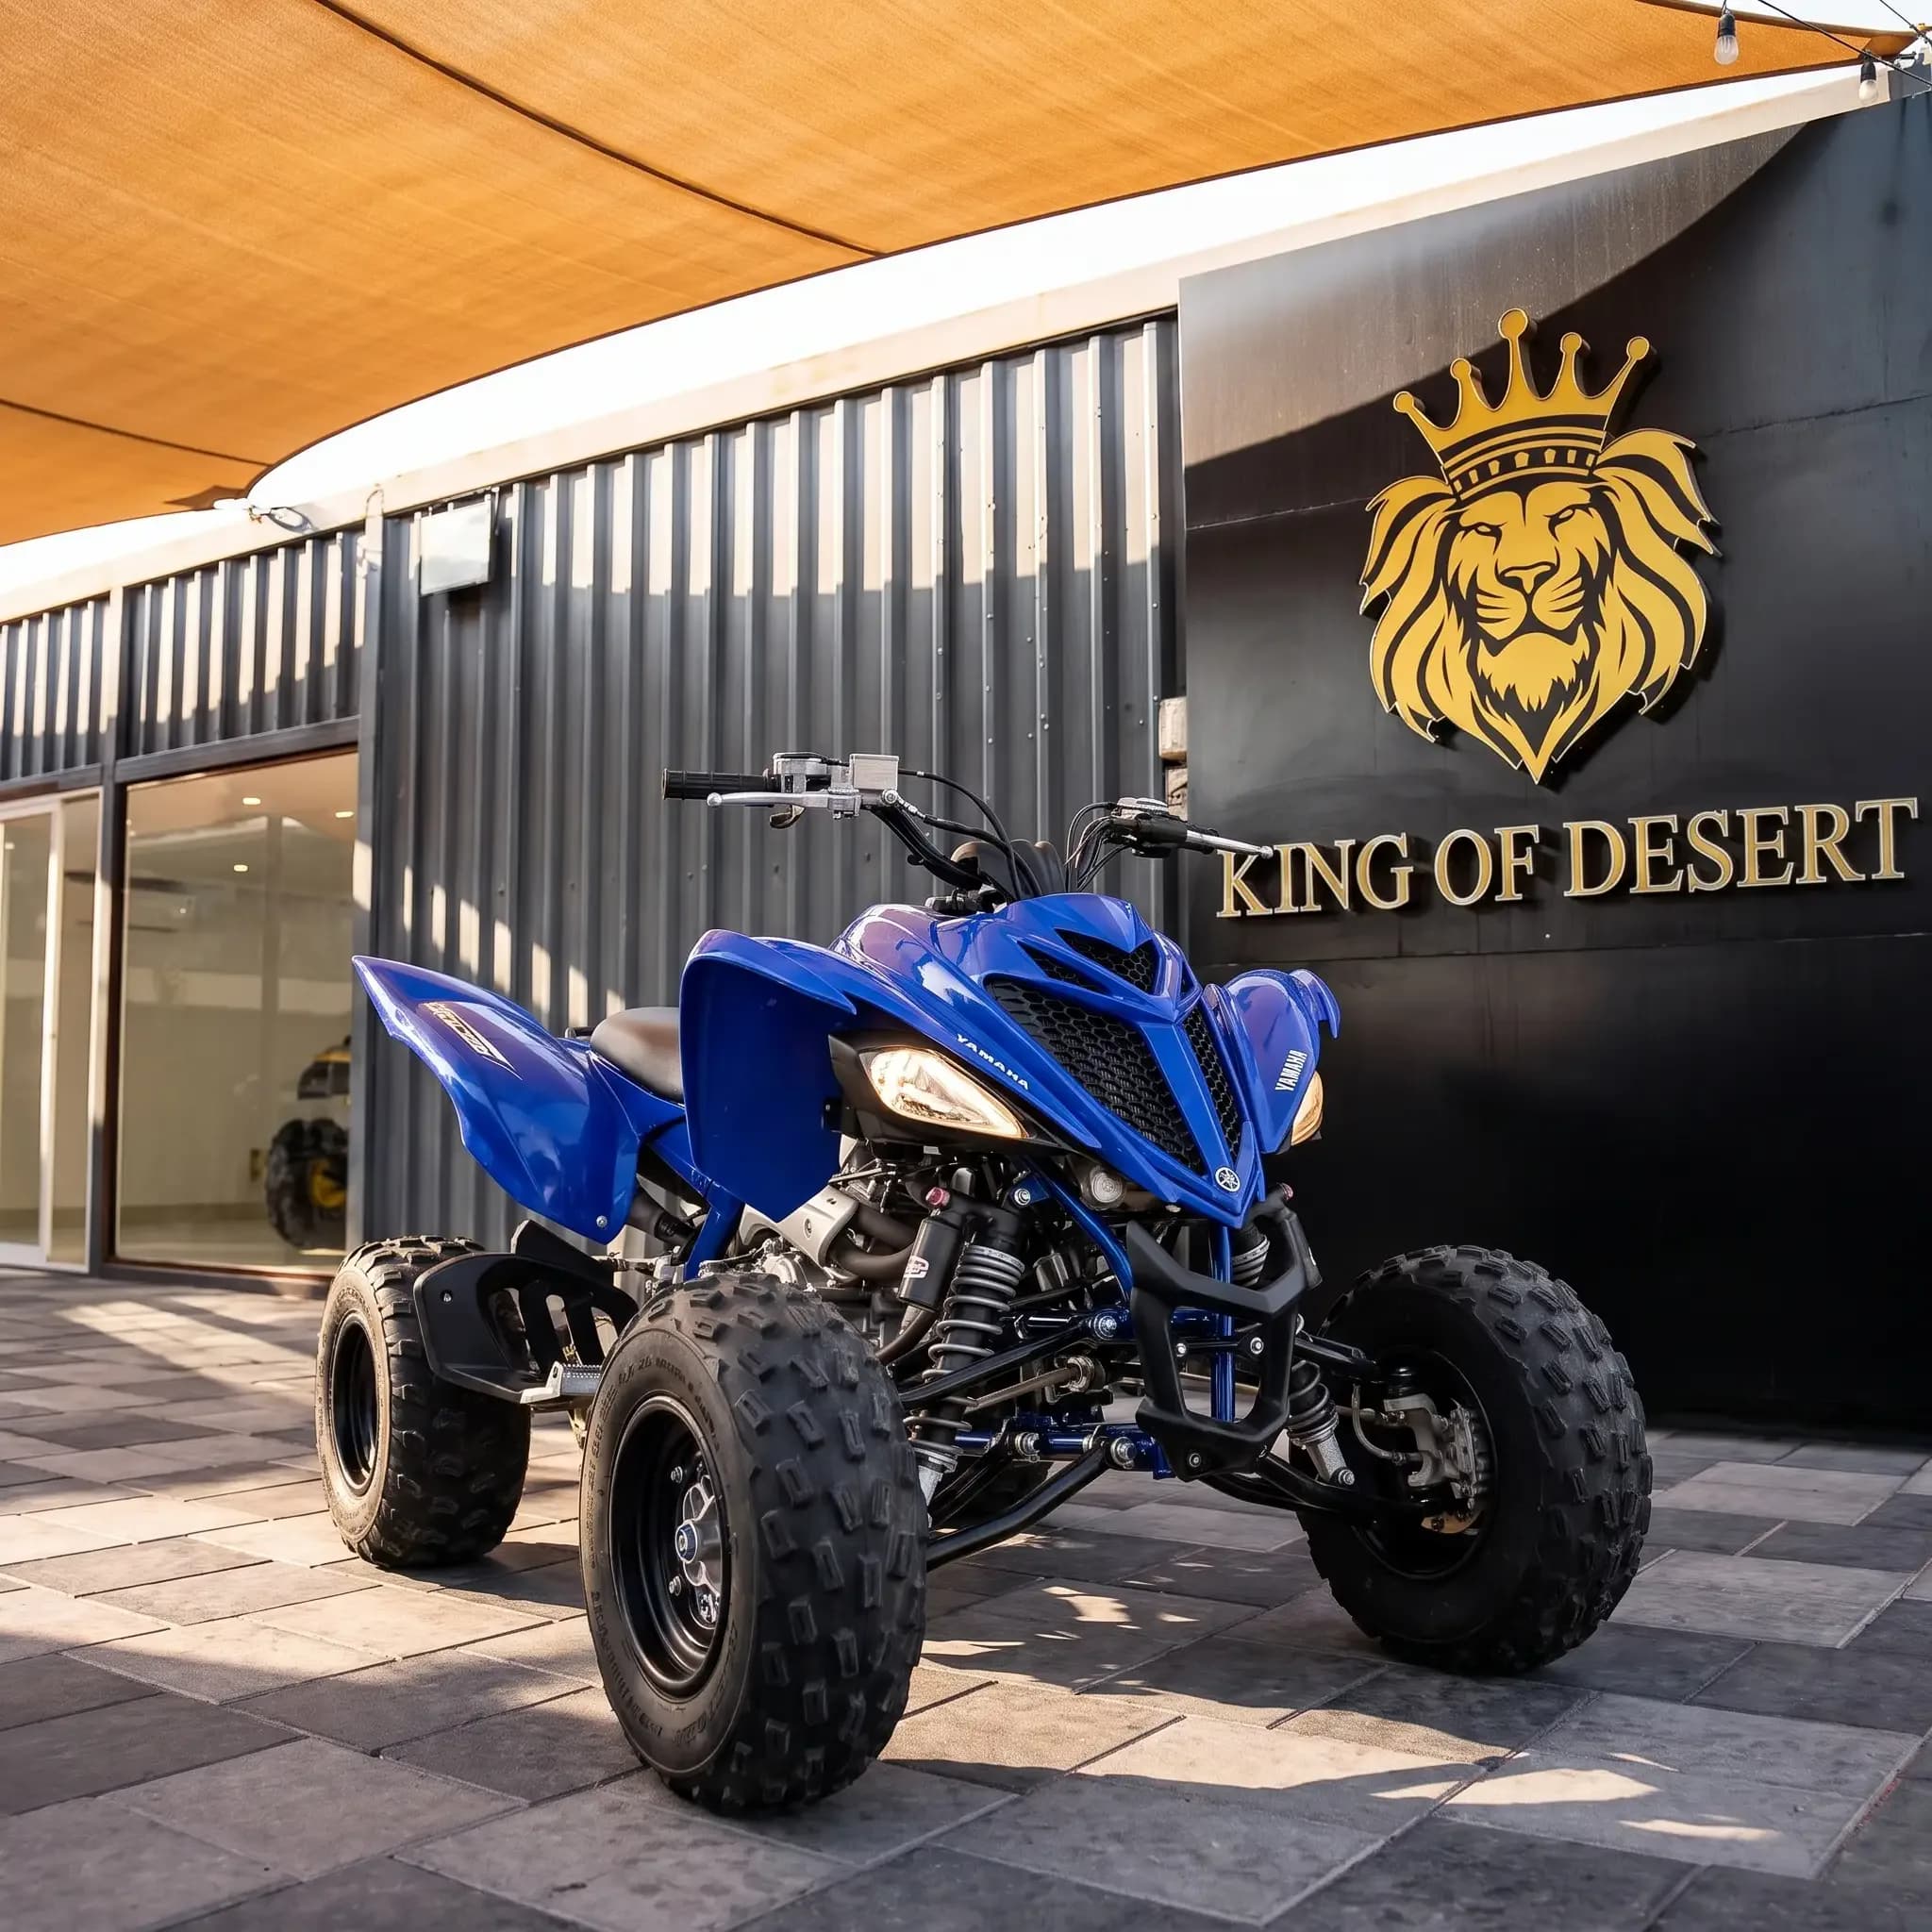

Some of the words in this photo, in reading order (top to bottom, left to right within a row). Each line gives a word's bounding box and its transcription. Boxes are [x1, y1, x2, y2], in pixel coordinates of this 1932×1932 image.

[1217, 832, 1413, 918] KING
[1434, 824, 1540, 907] OF
[1562, 797, 1918, 895] DESERT
[958, 1034, 1028, 1090] YAMAHA
[1274, 1049, 1307, 1091] YAMAHA
